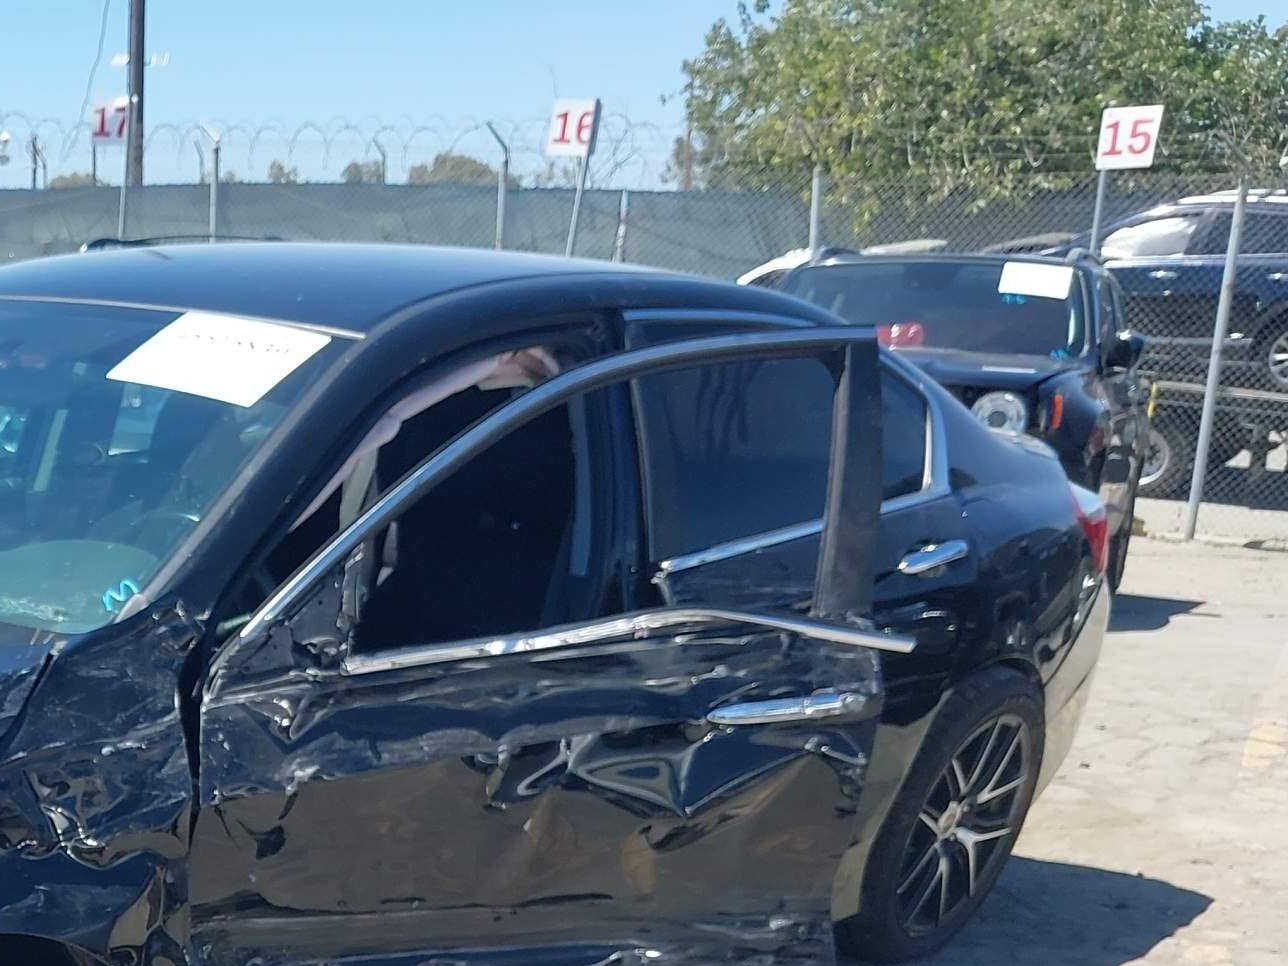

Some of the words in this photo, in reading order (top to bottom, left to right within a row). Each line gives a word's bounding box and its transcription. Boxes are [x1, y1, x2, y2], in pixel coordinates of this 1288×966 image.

[92, 106, 127, 138] 17
[552, 111, 595, 144] 16
[1101, 117, 1155, 156] 15
